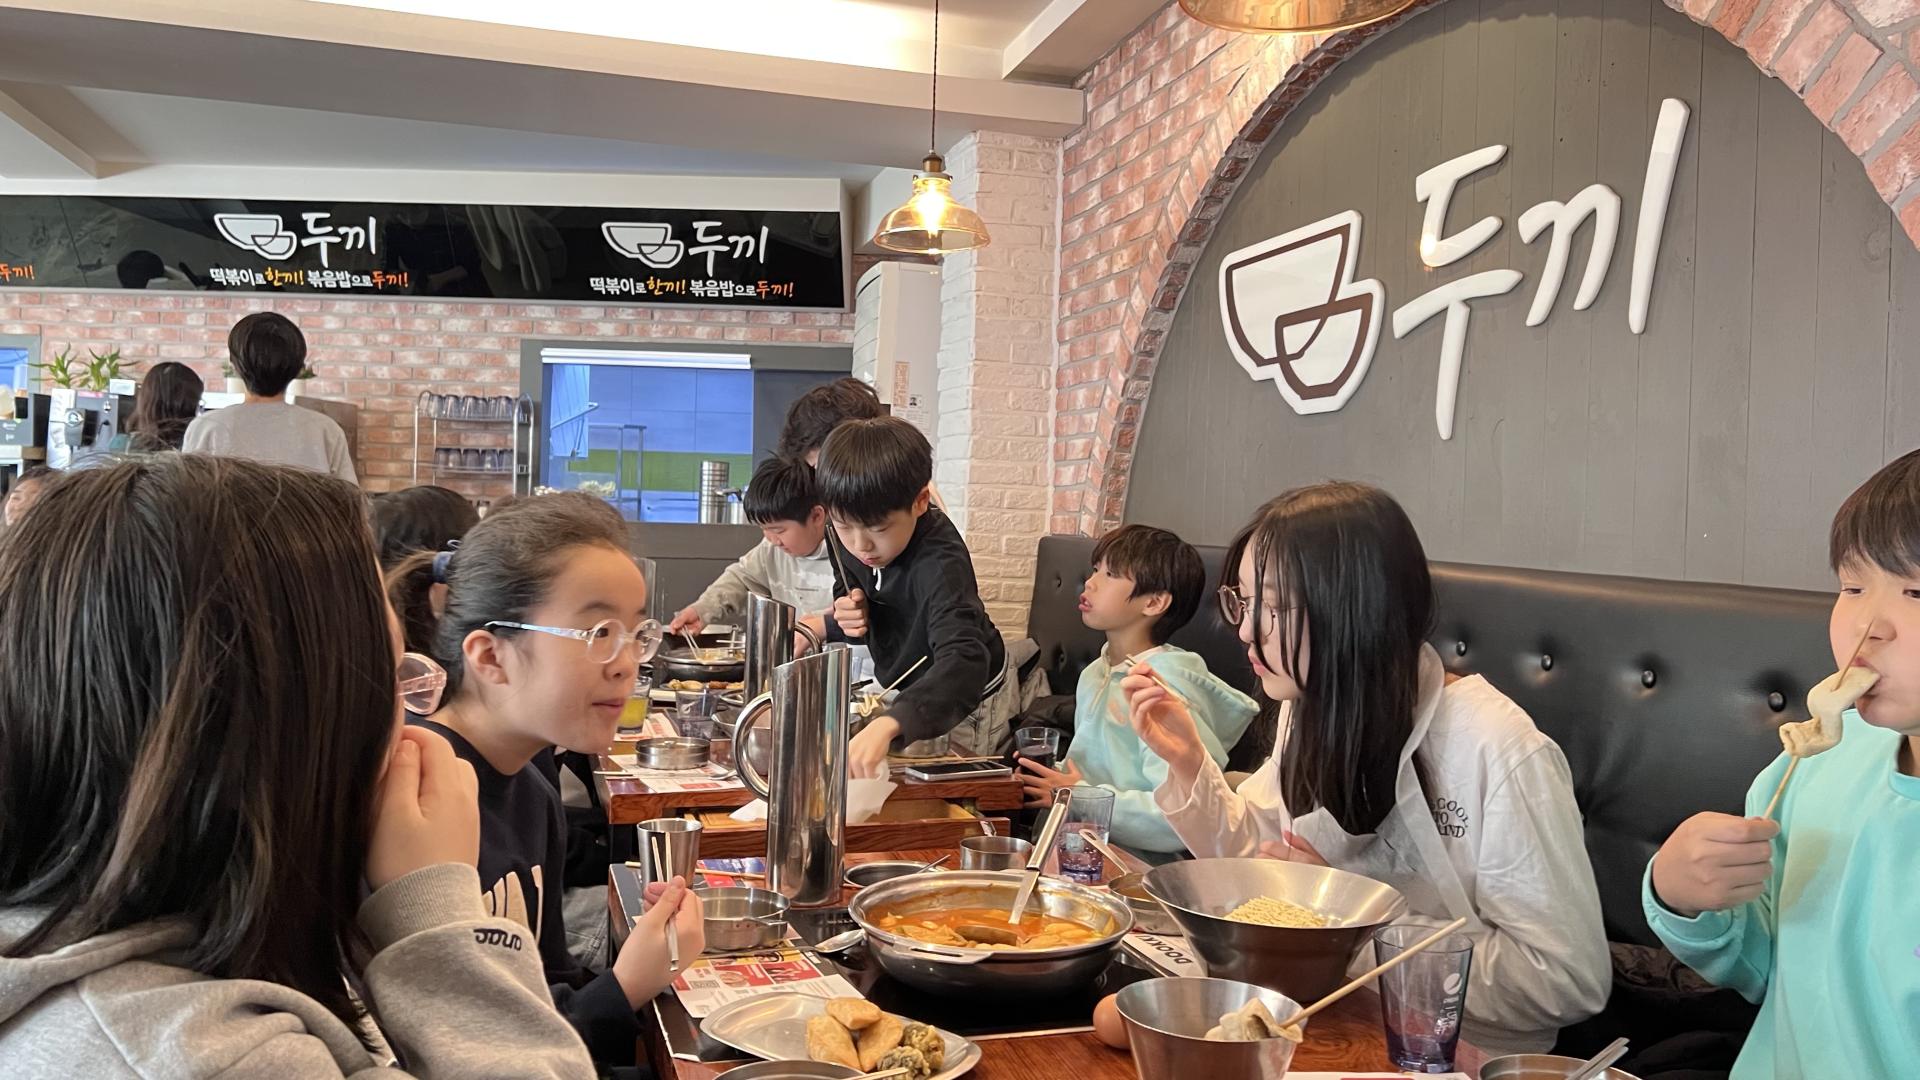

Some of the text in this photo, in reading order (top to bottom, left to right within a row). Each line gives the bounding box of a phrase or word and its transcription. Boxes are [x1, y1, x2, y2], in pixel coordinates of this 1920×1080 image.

[301, 211, 377, 268] 두끼
[688, 221, 769, 277] 두끼
[1393, 97, 1691, 440] 두끼
